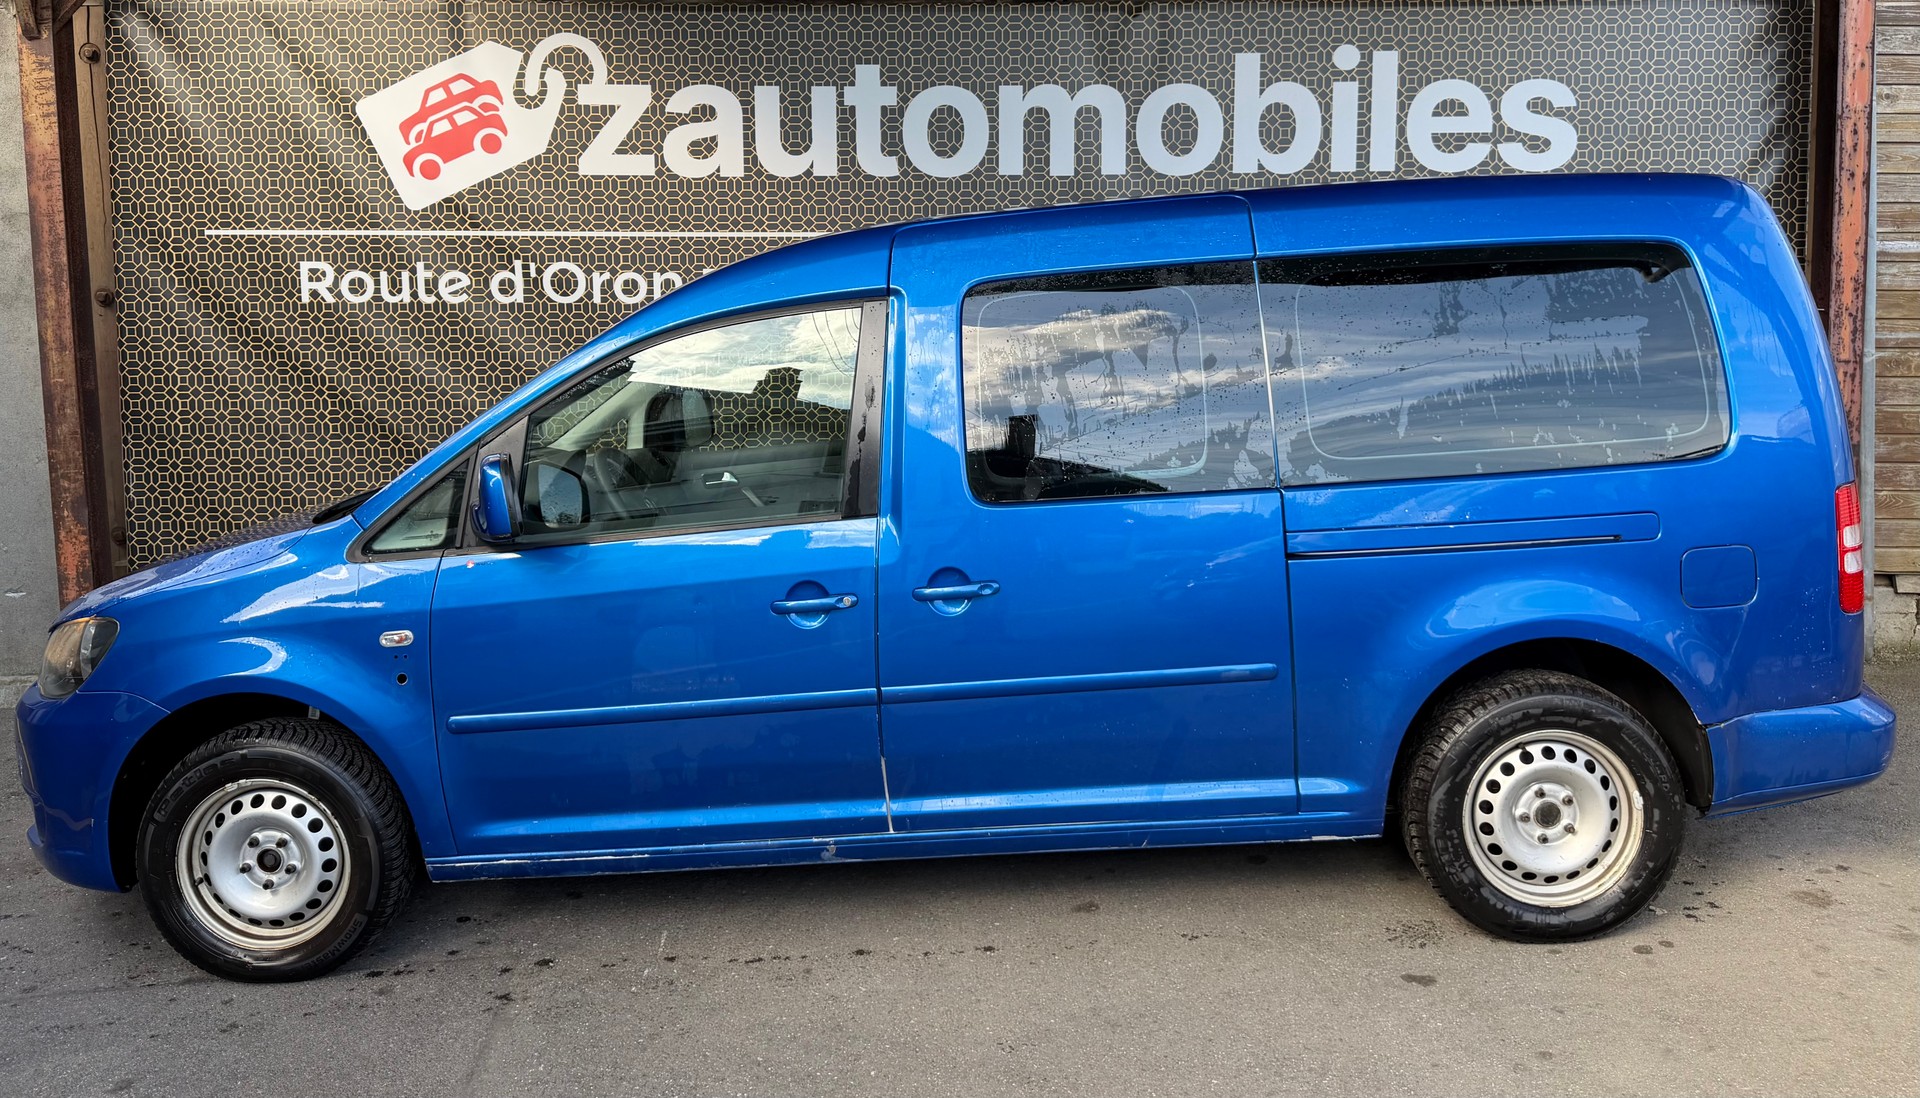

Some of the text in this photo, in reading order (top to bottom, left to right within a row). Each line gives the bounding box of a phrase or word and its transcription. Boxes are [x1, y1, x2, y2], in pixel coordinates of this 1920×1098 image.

[578, 45, 1578, 177] zautomobiles
[300, 260, 683, 304] Route d'Oron
[302, 918, 363, 969] SnowMaste
